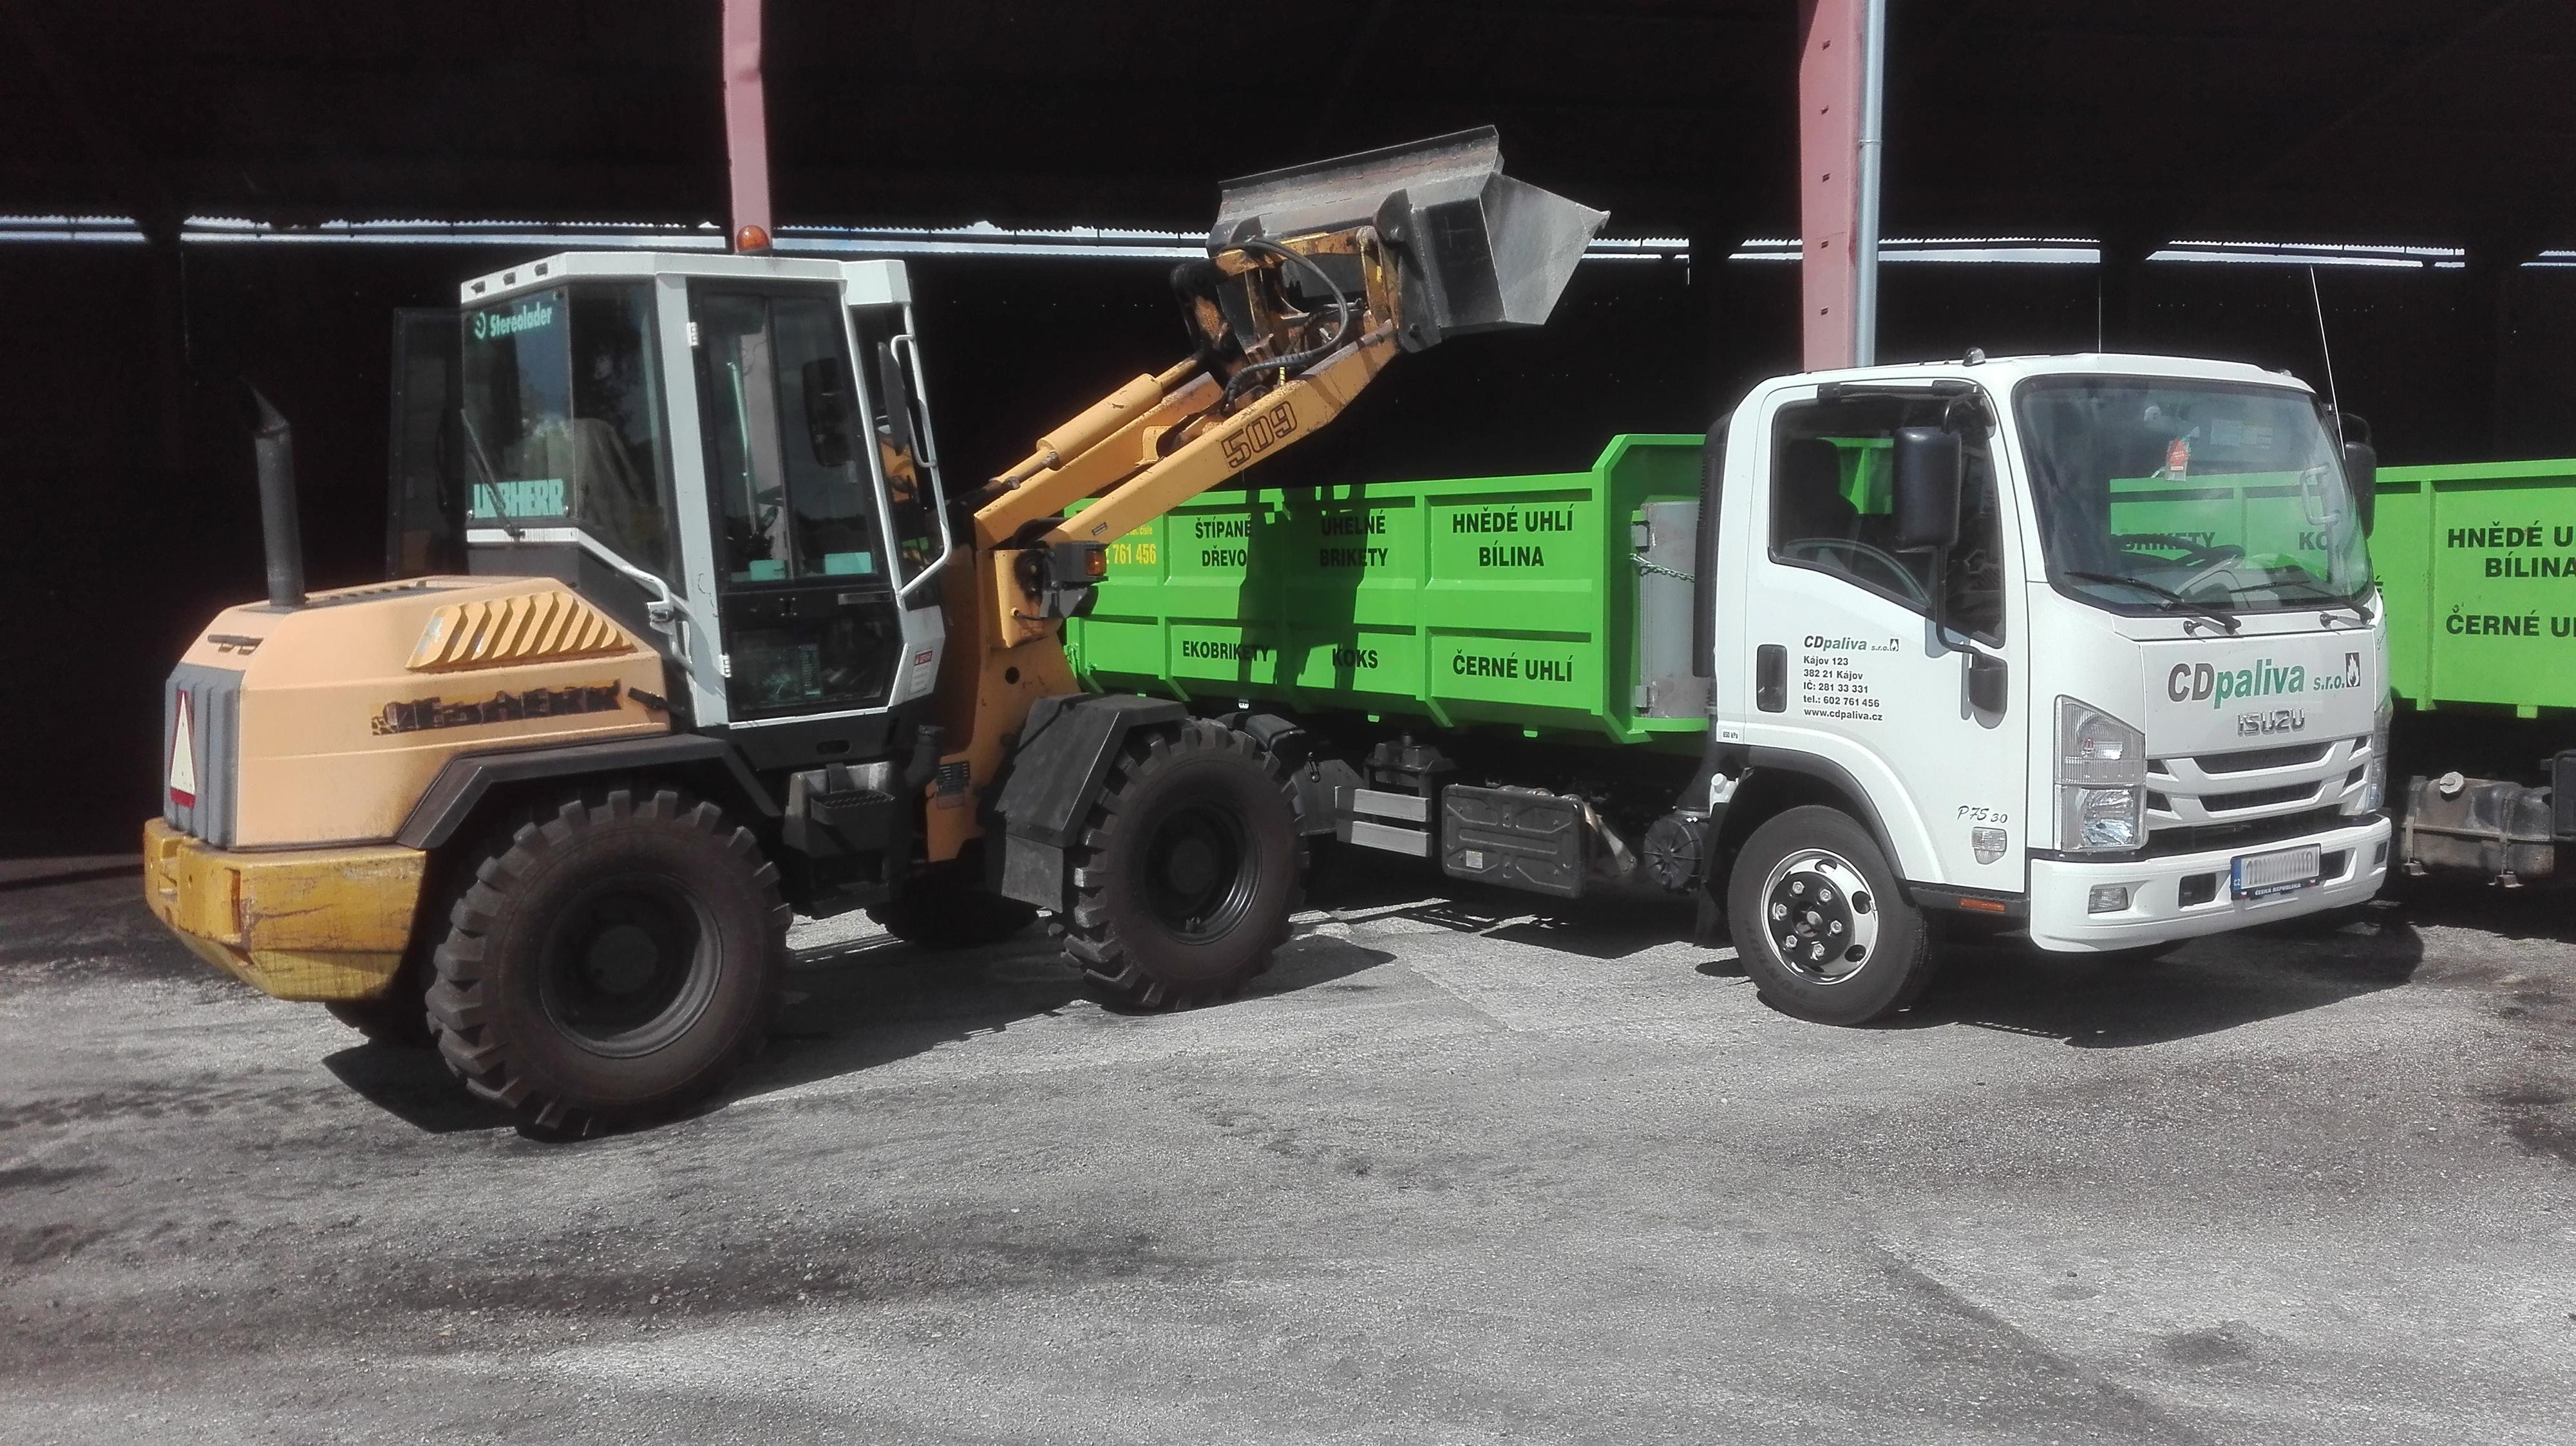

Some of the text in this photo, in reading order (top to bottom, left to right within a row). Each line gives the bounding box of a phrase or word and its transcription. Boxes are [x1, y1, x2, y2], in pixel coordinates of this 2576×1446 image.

[490, 301, 552, 337] Stereolader
[1220, 400, 1297, 468] 509
[1195, 514, 1252, 539] ŠTÍPANÉ
[1321, 509, 1386, 536] UHELNÉ
[1453, 503, 1574, 533] HNĚDÉ UHLÍ
[2448, 520, 2543, 548] HNĚDÉ
[1112, 543, 1132, 564] 761
[1136, 543, 1157, 564] 456
[1202, 545, 1247, 567] DŘEVO
[1320, 547, 1388, 567] BRIKETY
[1479, 540, 1544, 567] BÍLINA
[2485, 551, 2576, 577] BÍLINA
[2446, 608, 2576, 637] ČERNÉ U
[1182, 640, 1270, 662] EKOBRIKETY
[1804, 635, 1867, 652] CDpaliva
[1332, 648, 1378, 669] KOKS
[1453, 649, 1573, 682] ČERNÉ UHLÍ
[1804, 655, 1848, 666] Kájov 123
[1804, 669, 1820, 677] 382
[1837, 670, 1863, 681] Kájov
[2168, 659, 2345, 709] CDpaliva s.r.o.
[1804, 680, 1868, 693] IČ: 281 33 331
[1803, 695, 1880, 708] tel.: 602 761 456
[1804, 709, 1883, 720] www.cdpaliva.cz
[2237, 708, 2306, 737] ISUZU
[1957, 805, 2008, 823] P75 30
[2272, 883, 2301, 892] REPUBLIKA
